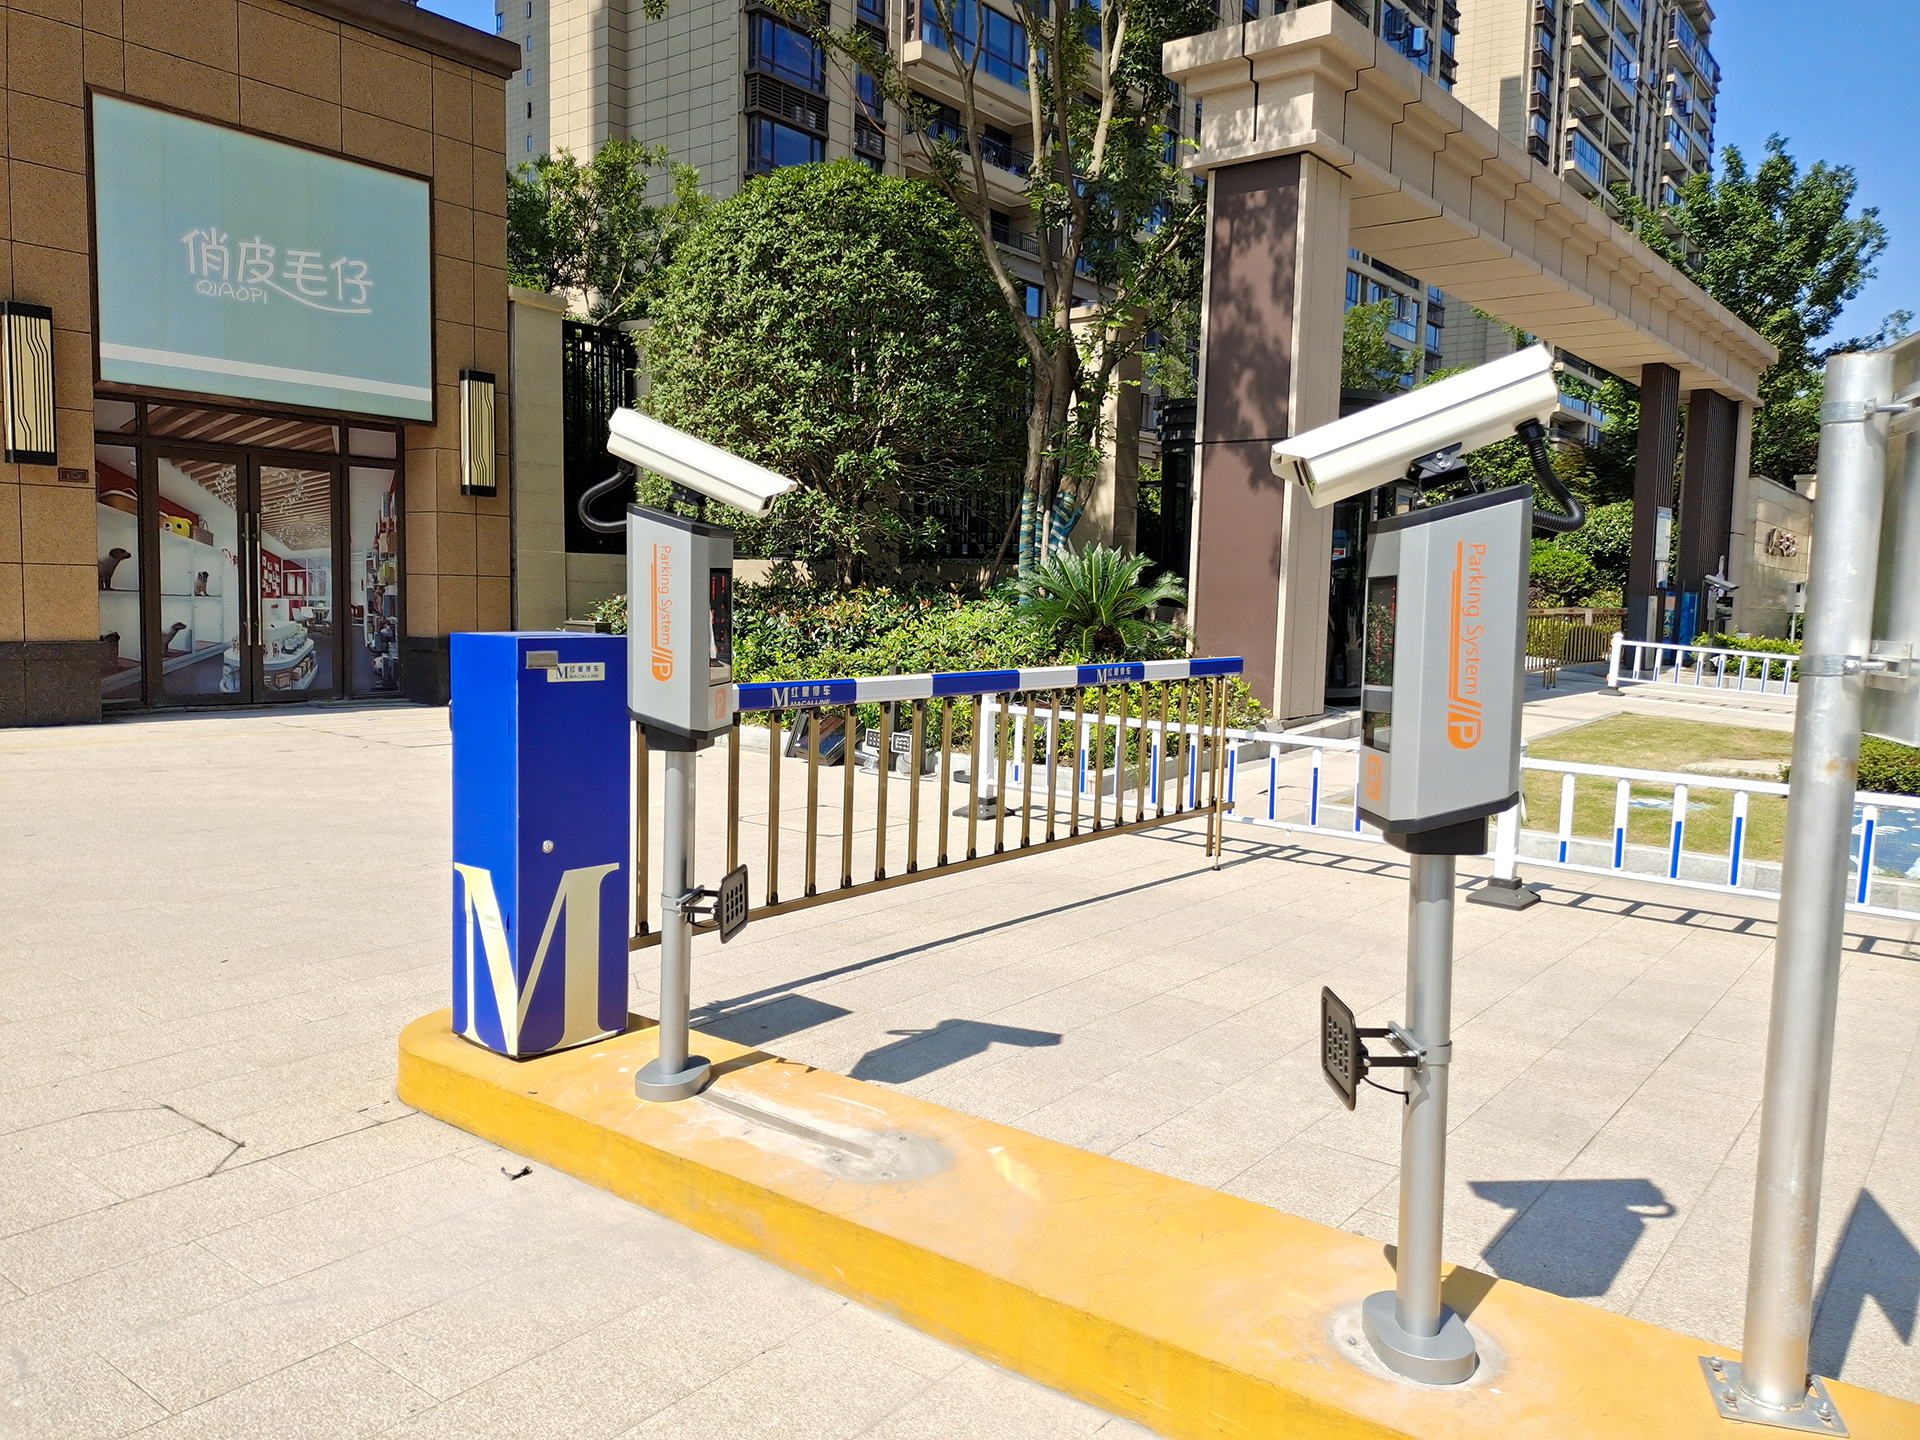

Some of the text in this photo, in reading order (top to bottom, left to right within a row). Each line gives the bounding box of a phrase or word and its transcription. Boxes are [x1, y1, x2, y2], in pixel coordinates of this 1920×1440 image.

[181, 227, 373, 308] 俏皮毛仔
[196, 280, 267, 304] QIAOPI
[657, 545, 672, 646] Parking System
[1460, 544, 1487, 695] Parking System
[653, 663, 671, 677] P
[1096, 668, 1107, 684] M
[770, 687, 790, 709] M
[1449, 720, 1479, 744] P
[453, 862, 620, 1059] M
